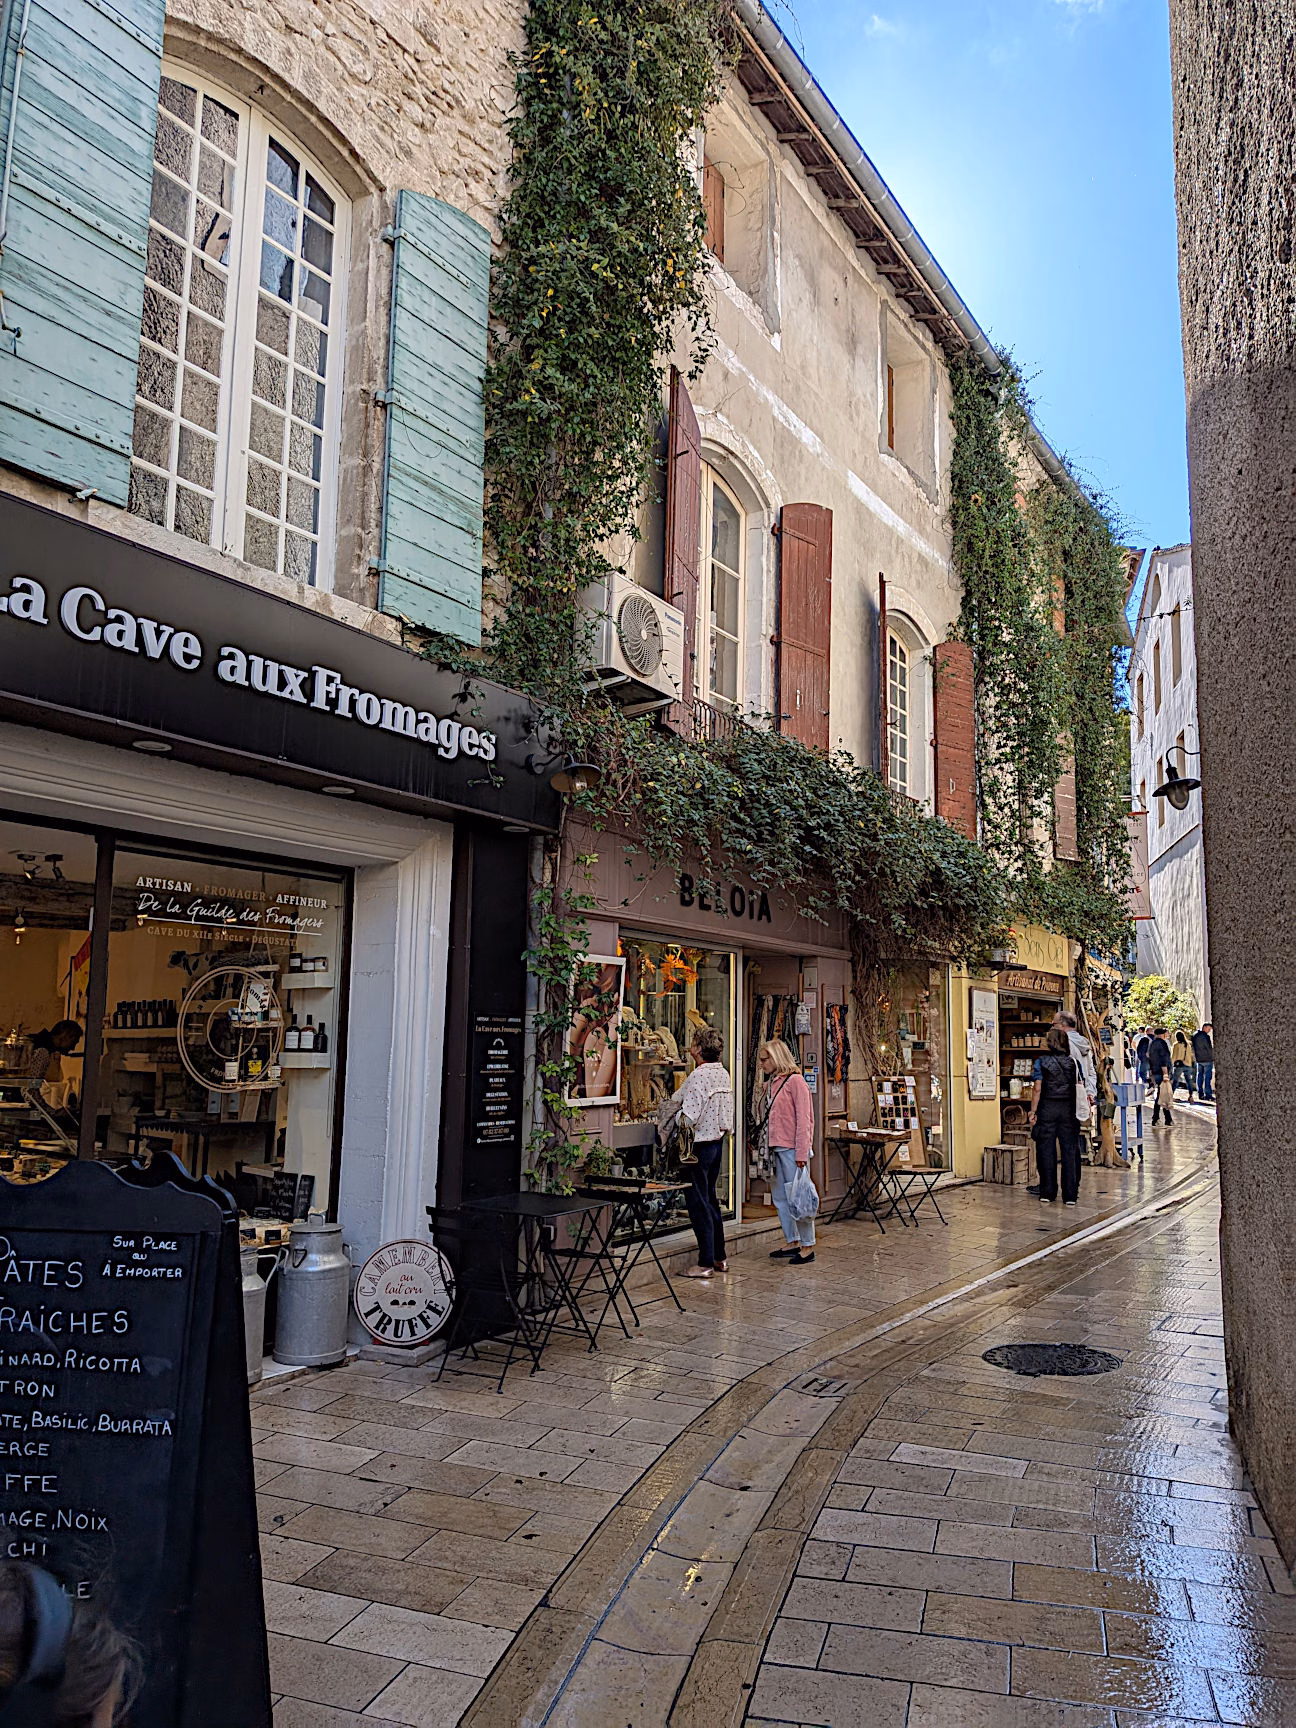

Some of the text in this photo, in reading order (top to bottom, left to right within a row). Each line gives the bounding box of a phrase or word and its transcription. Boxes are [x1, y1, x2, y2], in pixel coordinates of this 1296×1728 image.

[61, 586, 202, 670] Cave
[218, 646, 309, 704] aux
[310, 665, 497, 761] Fromages
[136, 876, 328, 910] ARTISAN FROMAGER AFFINEUR
[138, 892, 325, 933] De la Guilde des Fromagers
[147, 925, 175, 937] CAVE
[176, 927, 191, 938] DU
[143, 1236, 178, 1250] PLACE
[116, 1264, 183, 1278] EMPORTER
[400, 1274, 415, 1282] au
[384, 1281, 404, 1295] lait
